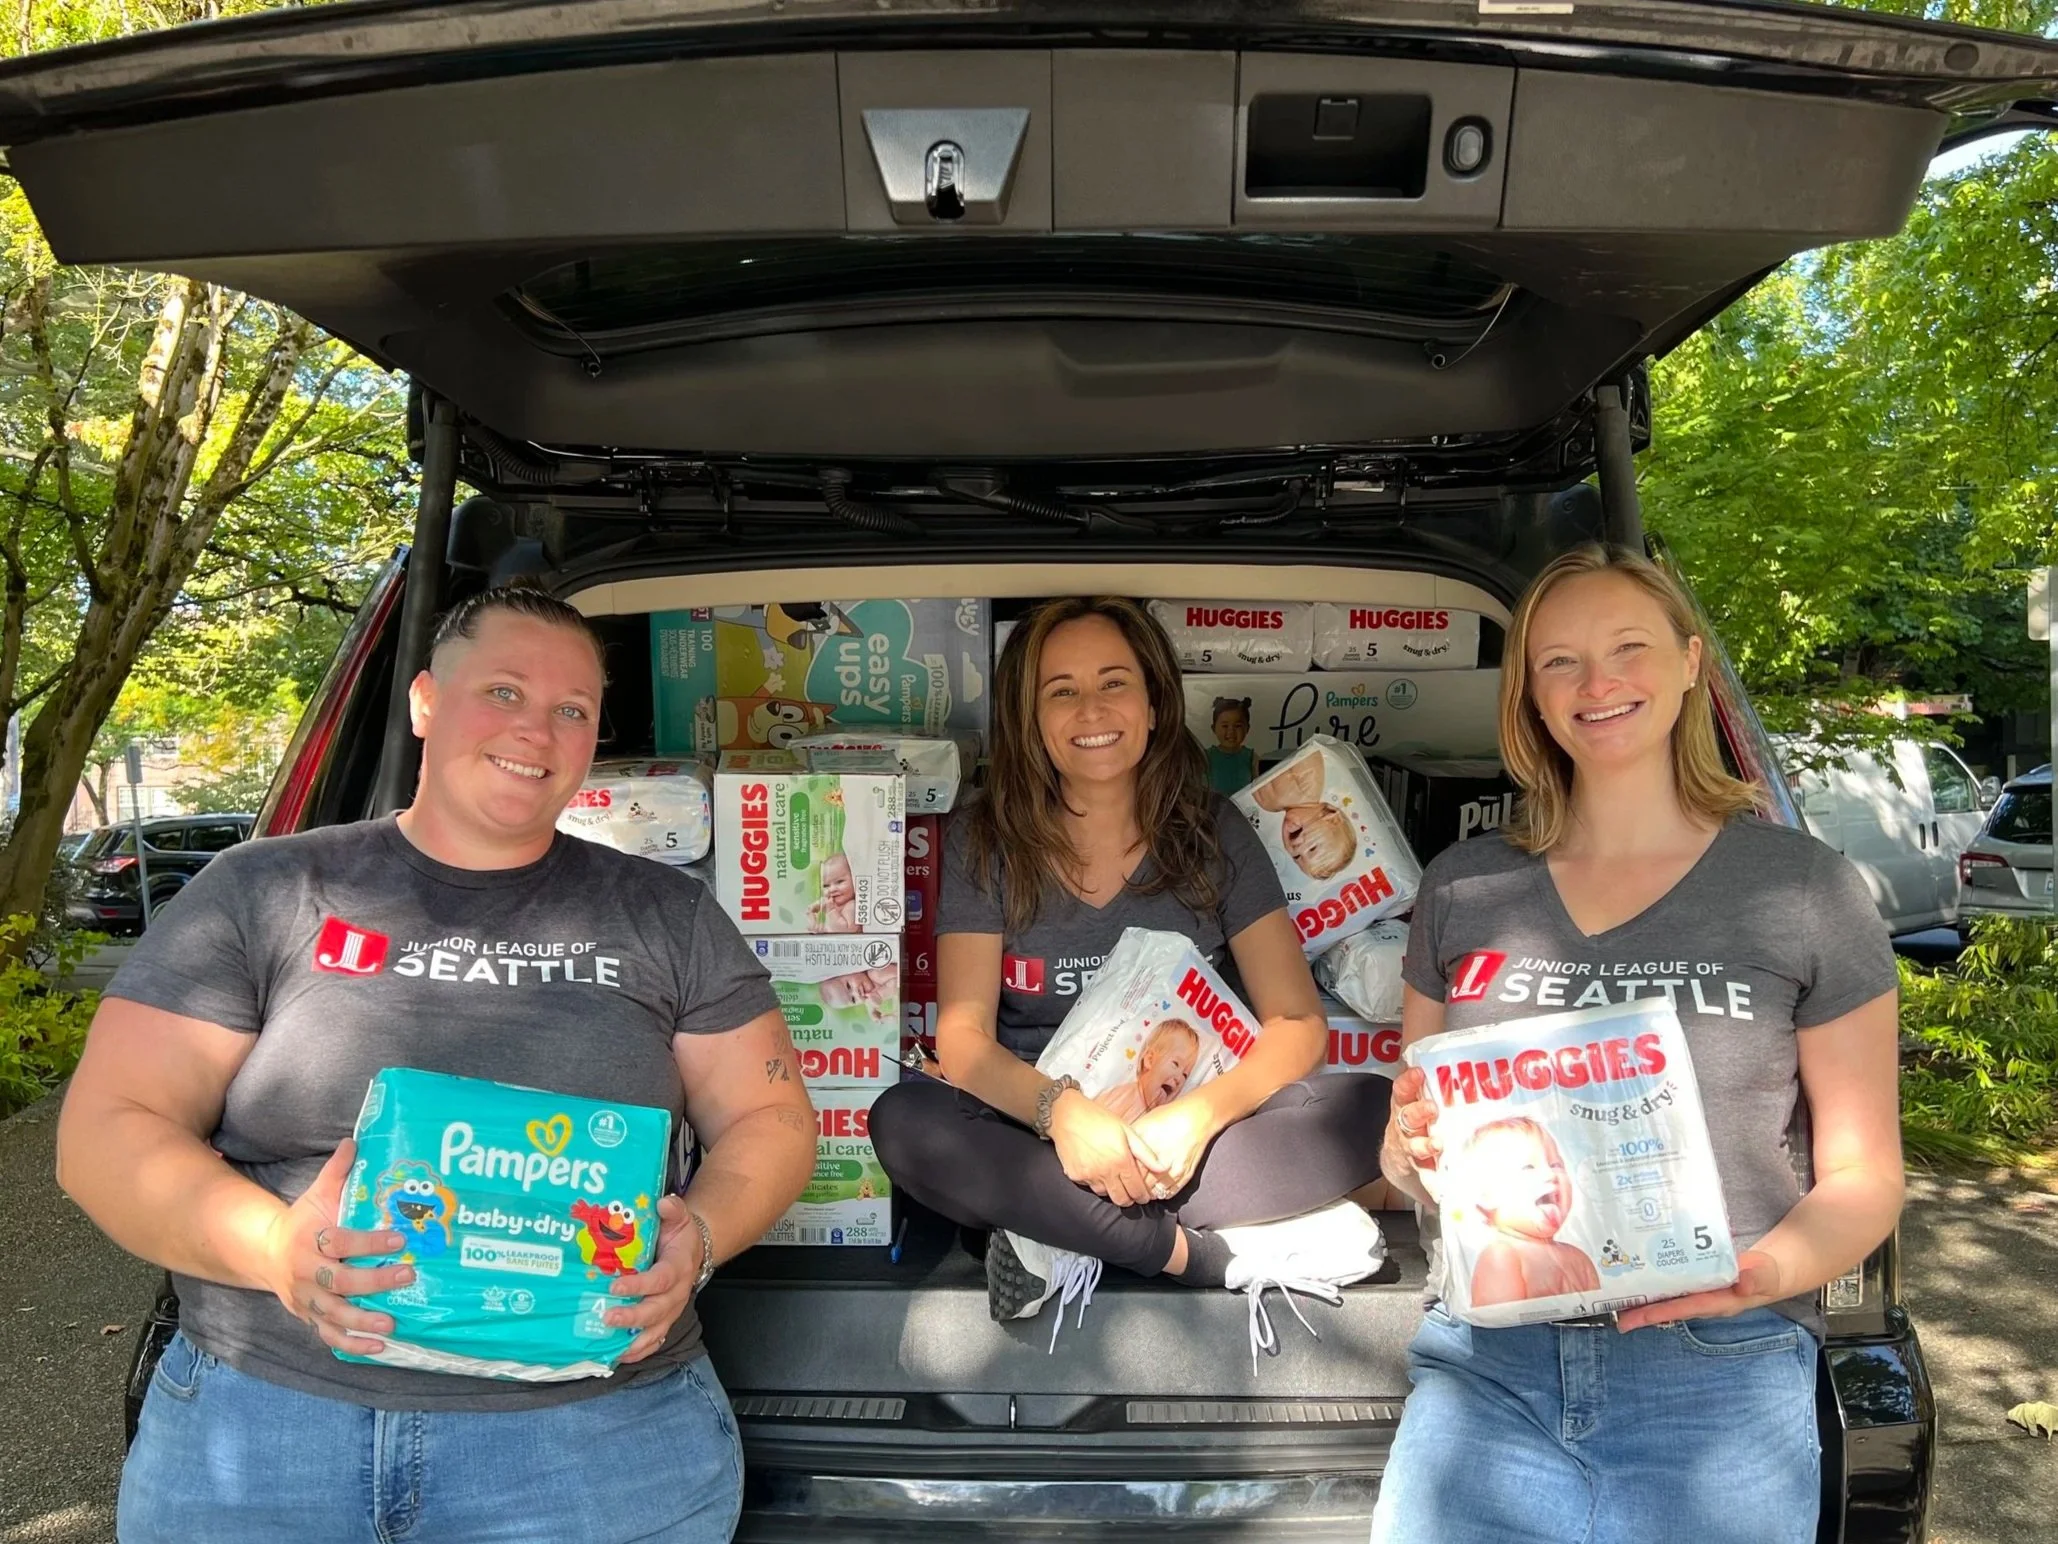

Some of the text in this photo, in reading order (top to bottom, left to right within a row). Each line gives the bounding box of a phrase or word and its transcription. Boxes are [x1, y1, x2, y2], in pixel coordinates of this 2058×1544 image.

[1186, 607, 1283, 630] HUGGIES
[1350, 609, 1449, 630] HUGGIES
[687, 629, 696, 668] TRAINING
[700, 629, 712, 651] 100
[1367, 643, 1377, 656] 5
[679, 629, 688, 679] UNDERWEAR
[1202, 650, 1213, 662] 5
[1237, 652, 1258, 664] snug
[1403, 644, 1423, 657] snug
[834, 641, 862, 706] ups
[864, 633, 891, 715] easy
[900, 674, 916, 723] Pampers
[1394, 683, 1406, 695] #1
[1326, 691, 1378, 709] Pampers
[926, 788, 936, 802] 5
[888, 796, 897, 818] 288
[568, 814, 587, 826] snug
[588, 818, 595, 826] &
[665, 832, 678, 848] 5
[772, 783, 787, 879] natural care
[792, 812, 801, 850] sensitive
[740, 783, 770, 921] HUGGIES
[878, 840, 889, 896] DO NOT FLUSH
[890, 871, 899, 883] AUX
[890, 885, 899, 896] PAS
[400, 937, 597, 957] JUNIOR LEAGUE OF
[805, 943, 862, 953] PAS AUX TOILETTES
[393, 950, 621, 988] SEATTLE
[805, 954, 863, 966] DO NOT FLUSH
[916, 952, 928, 970] 6
[1511, 957, 1724, 976] JUNIOR LEAGUE OF
[1498, 972, 1754, 1021] SEATTLE
[794, 1047, 880, 1078] HUG
[1436, 1033, 1668, 1107] HUGGIES
[1570, 1088, 1674, 1126] snug & dry
[599, 1115, 614, 1130] #1
[835, 1144, 873, 1156] care
[1618, 1137, 1665, 1157] 100%
[439, 1121, 609, 1194] Pampers
[846, 1227, 868, 1238] 288
[1694, 1225, 1713, 1250] 5
[1661, 1238, 1676, 1249] 25
[464, 1247, 560, 1262] 100% LEAKPROOF
[1656, 1257, 1689, 1267] COUCHES
[1657, 1249, 1685, 1259] DIAPERS
[506, 1258, 560, 1270] SANS FUITES
[591, 1298, 606, 1318] 4
